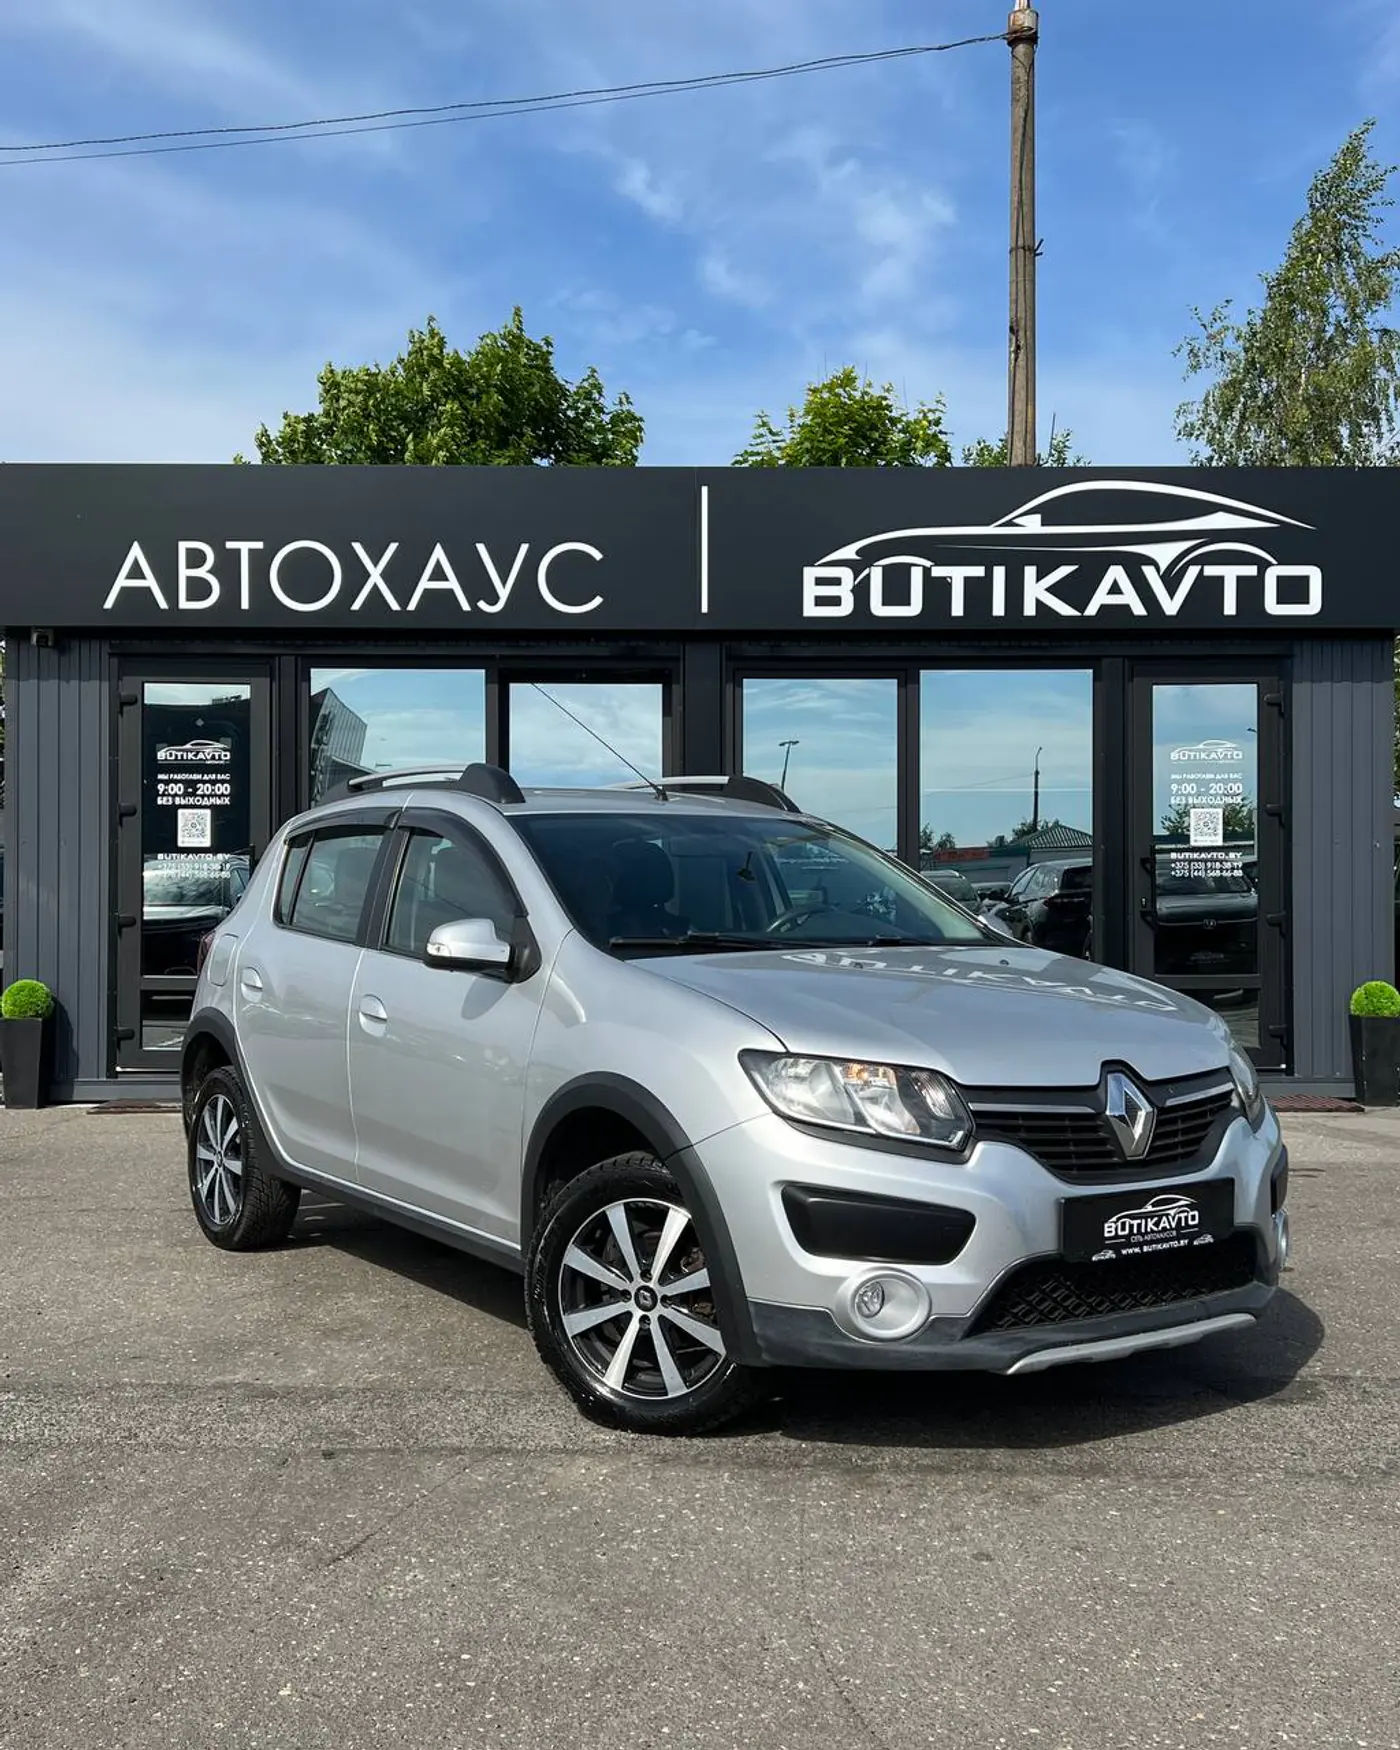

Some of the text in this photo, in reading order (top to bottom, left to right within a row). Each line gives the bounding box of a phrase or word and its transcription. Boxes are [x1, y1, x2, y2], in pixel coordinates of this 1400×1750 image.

[103, 540, 604, 614] АВТОХАУС
[802, 564, 1323, 617] BUTIKAVTO
[157, 751, 231, 760] BUTIKAVTO
[1170, 751, 1243, 760] BUTIKAVTO
[157, 783, 184, 795] 9:00
[196, 783, 231, 795] 20:00
[1170, 783, 1197, 794] 9:00
[1208, 783, 1243, 794] 20:00
[157, 796, 231, 806] БЕЗ ВЫХОДНЫХ
[1170, 795, 1243, 805] БЕЗ ВЫХОДНЫХ
[1170, 861, 1190, 869] +375
[1170, 869, 1190, 877] +375
[1104, 1211, 1199, 1237] BUTIKAVTO
